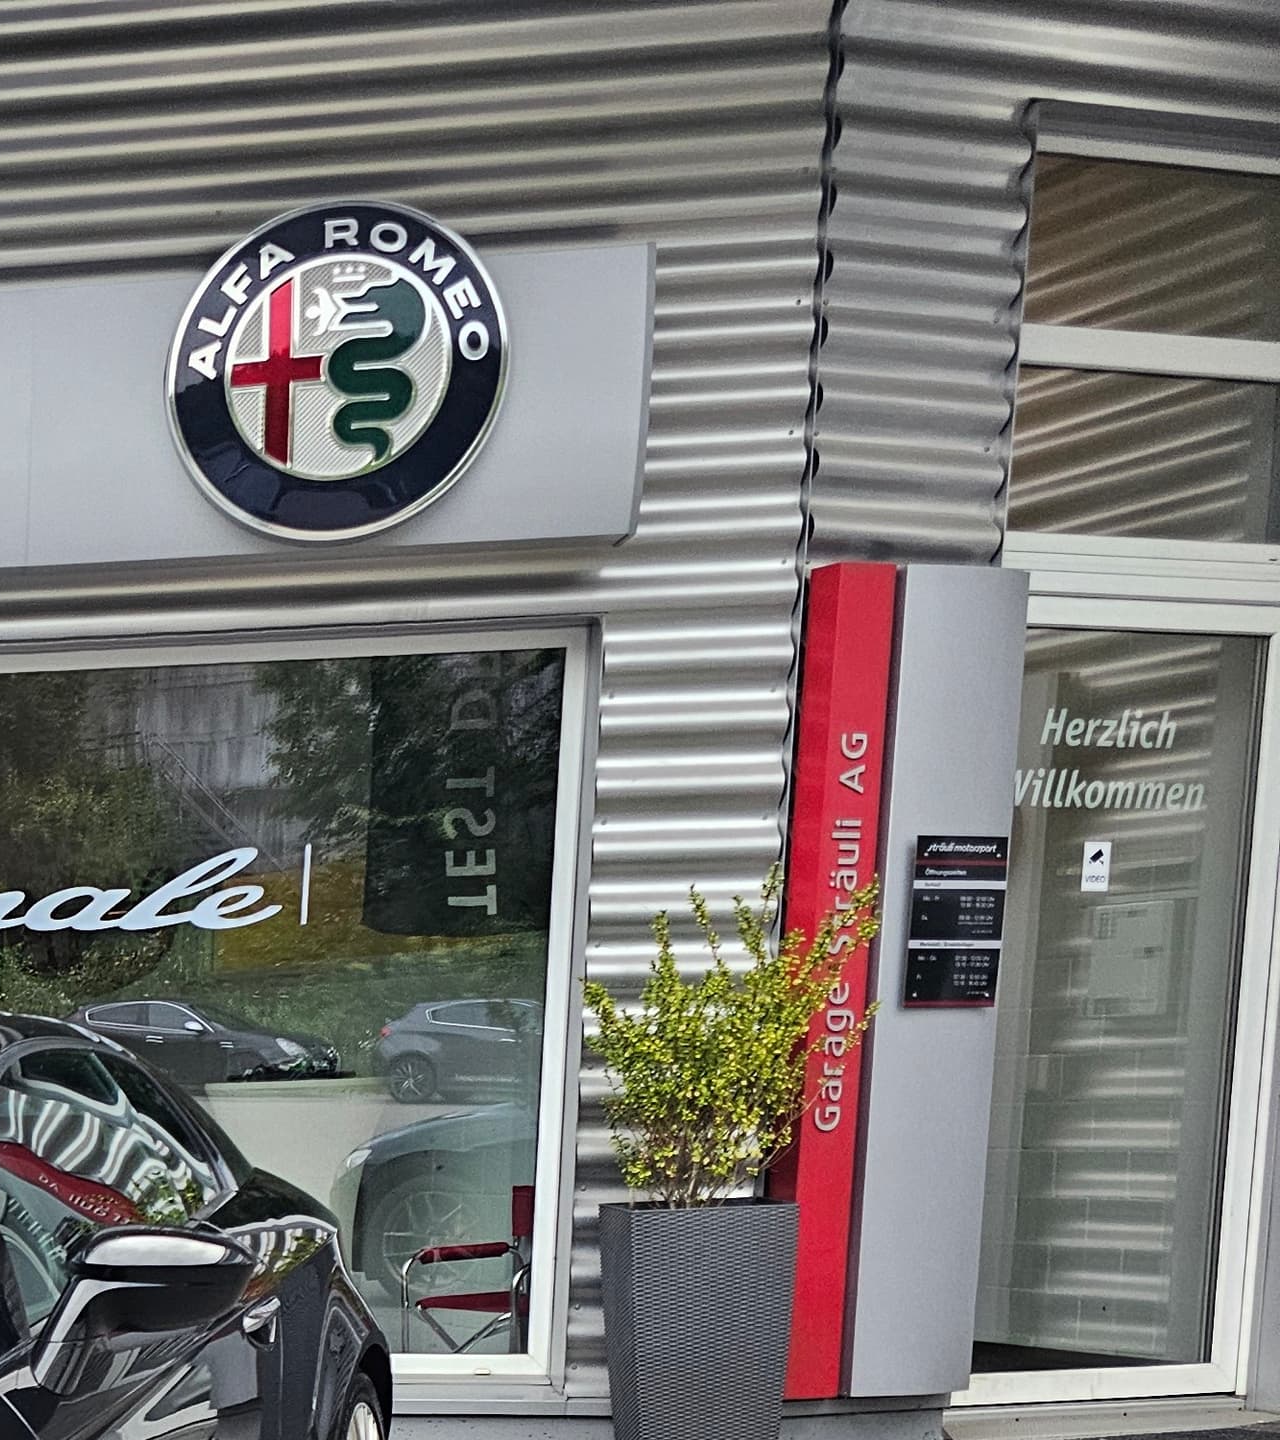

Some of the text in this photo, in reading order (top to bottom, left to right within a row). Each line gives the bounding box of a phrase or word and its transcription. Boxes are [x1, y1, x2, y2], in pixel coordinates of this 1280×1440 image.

[188, 217, 490, 380] ALFA ROMEO
[1040, 708, 1178, 749] Herzlich
[839, 732, 868, 794] AG
[1085, 875, 1105, 883] VIDEO
